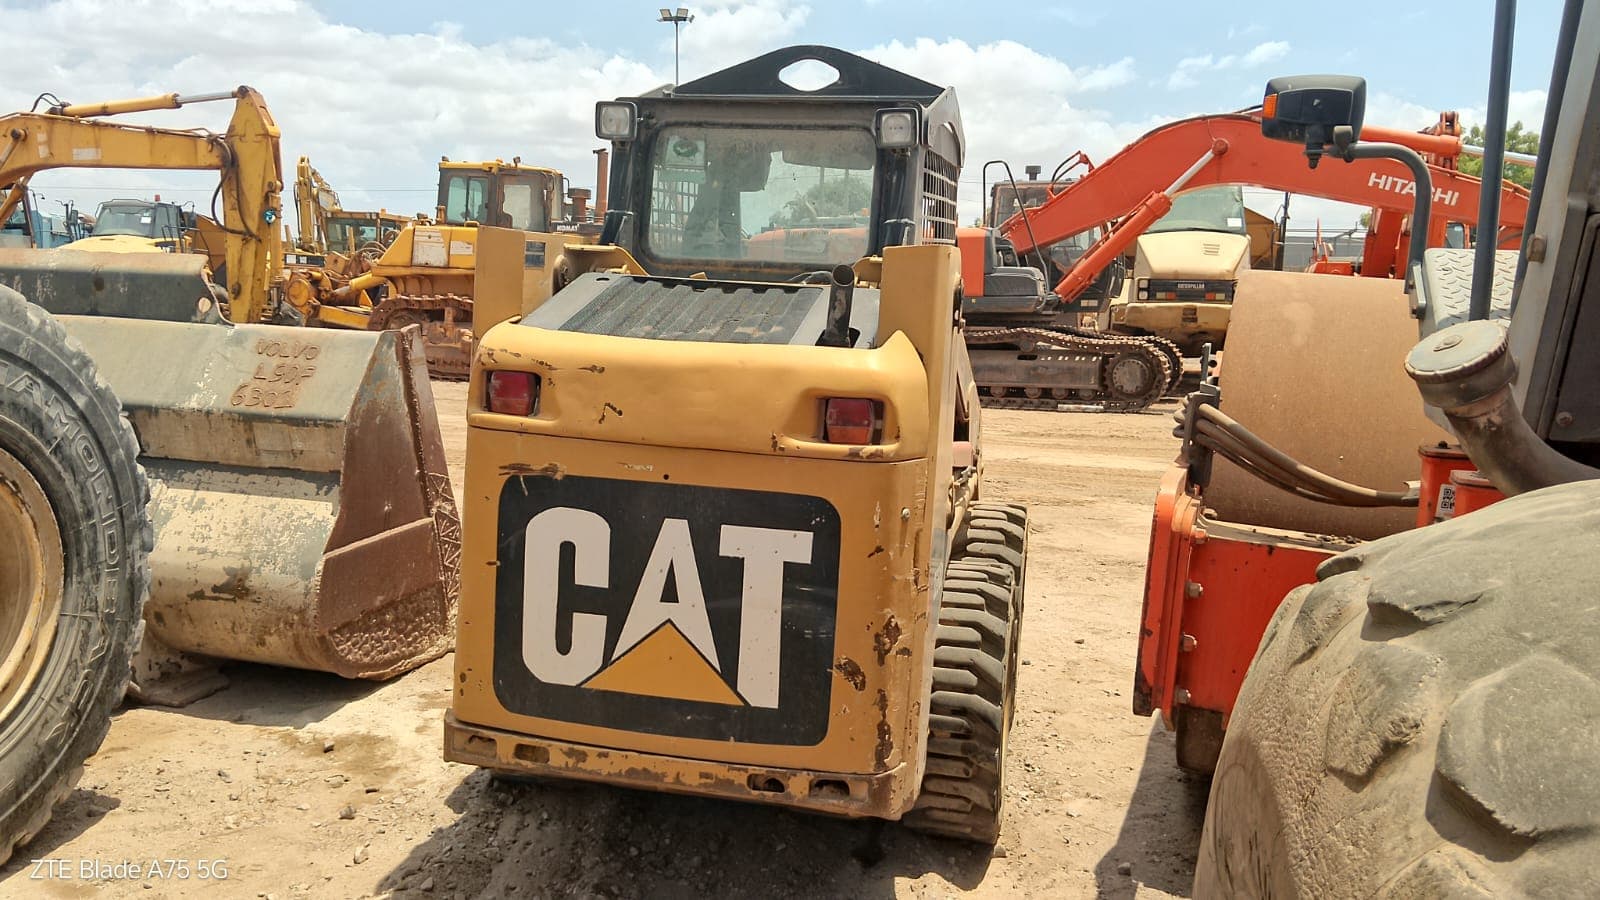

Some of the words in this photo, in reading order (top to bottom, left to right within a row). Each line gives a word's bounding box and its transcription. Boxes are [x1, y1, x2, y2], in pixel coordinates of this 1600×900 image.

[1367, 172, 1460, 207] HITAHI
[256, 338, 320, 361] VOLVO
[522, 506, 815, 709] CAT
